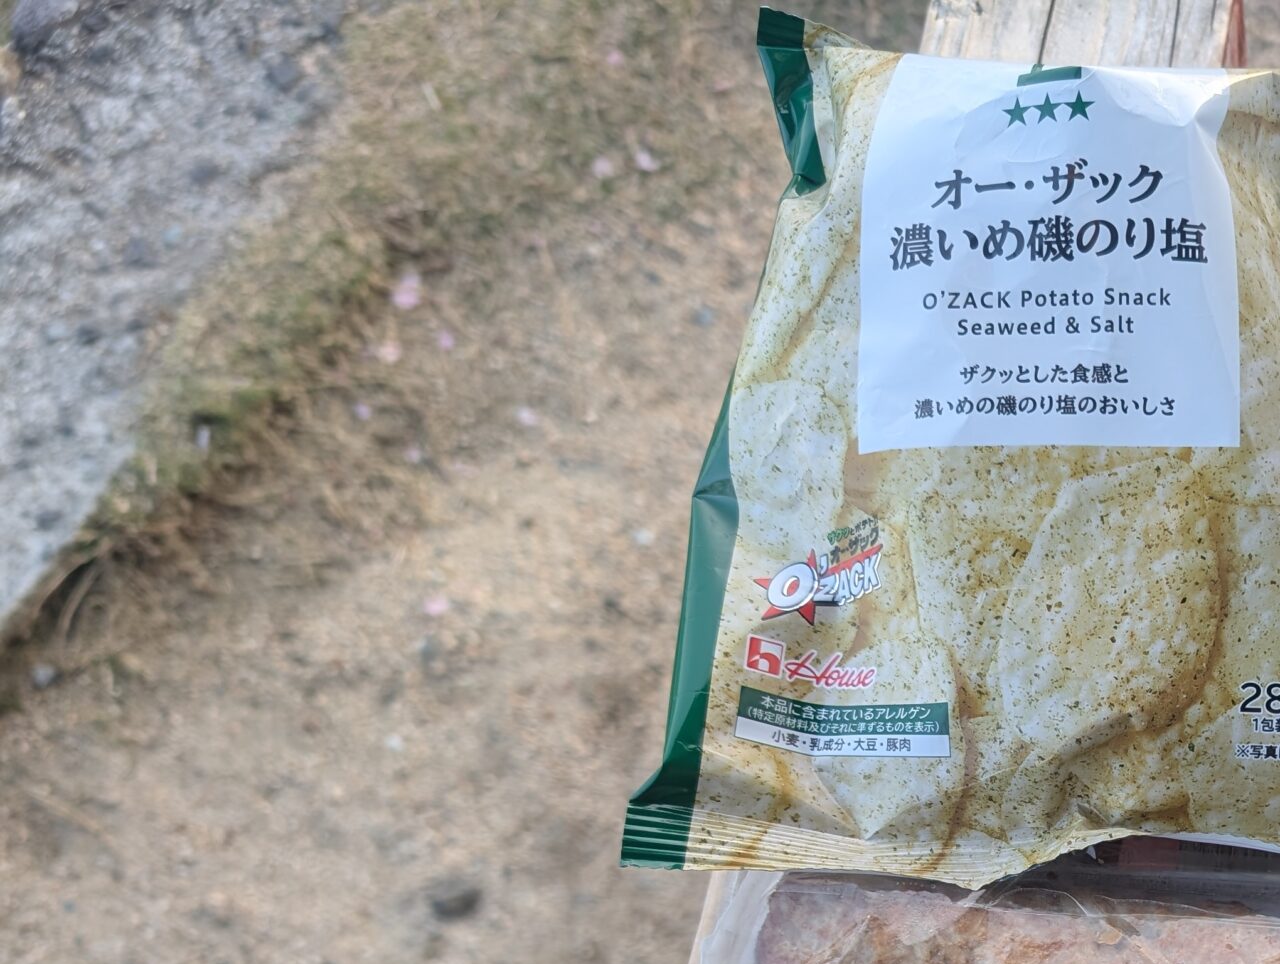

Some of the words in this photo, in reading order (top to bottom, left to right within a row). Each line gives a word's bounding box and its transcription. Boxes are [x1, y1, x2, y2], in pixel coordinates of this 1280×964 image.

[931, 158, 1164, 210] オー・ザック
[889, 215, 1209, 271] 濃いめ磯のり塩
[1020, 289, 1095, 308] Potato
[1104, 287, 1172, 307] Snack
[957, 317, 1056, 336] Seaweed
[1065, 317, 1081, 334] &
[1090, 315, 1135, 334] Salt
[959, 363, 1130, 386] ザクッとした食感と
[914, 394, 1177, 420] 濃いめの磯のり塩のおいしさ
[784, 650, 877, 688] House
[760, 695, 932, 721] 本品に含まれているアレルゲン
